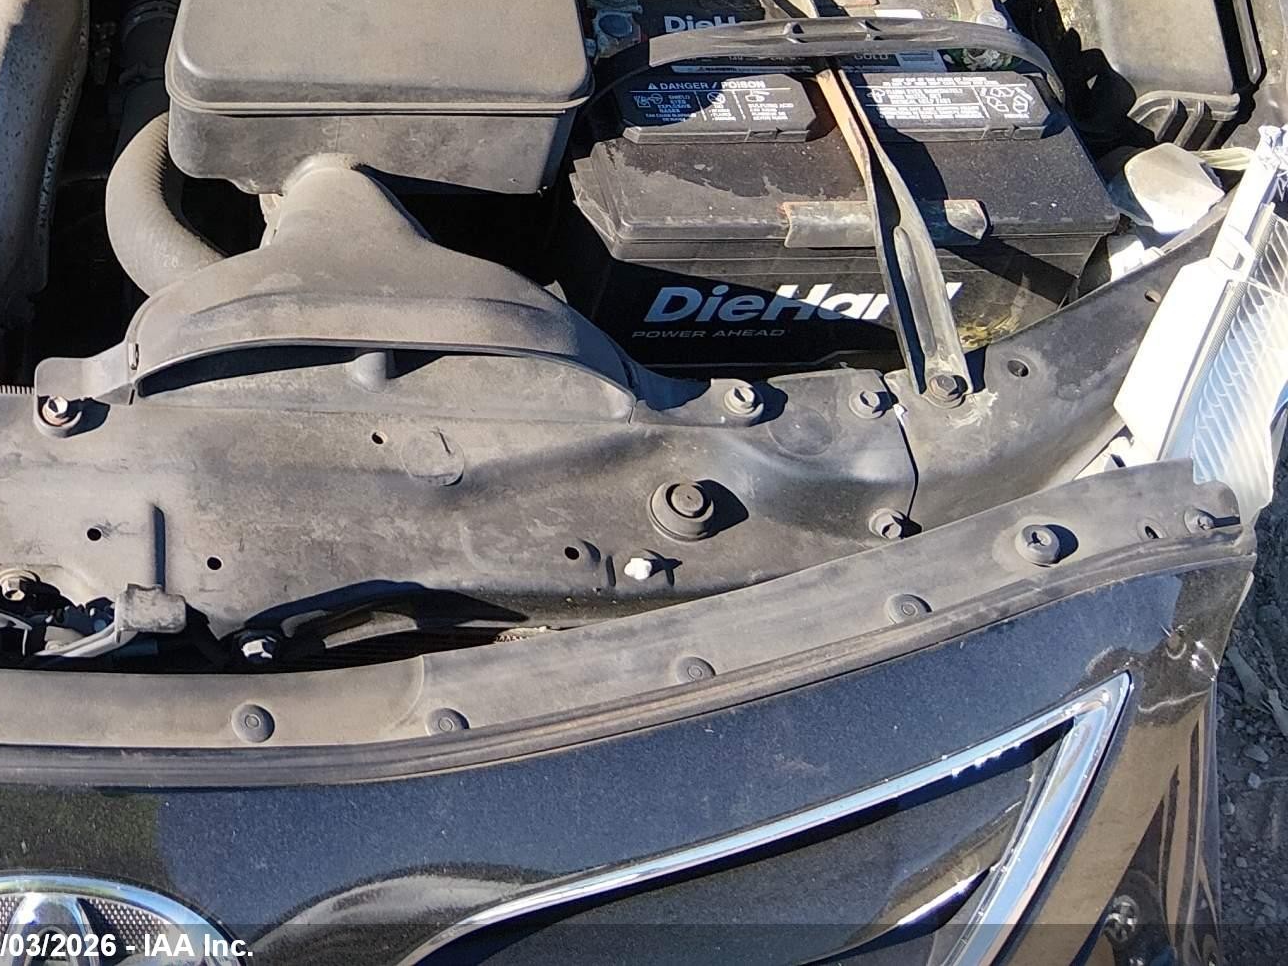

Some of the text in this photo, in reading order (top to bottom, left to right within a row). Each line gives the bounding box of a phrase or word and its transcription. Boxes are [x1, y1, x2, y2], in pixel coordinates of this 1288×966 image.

[659, 81, 709, 90] DANGER
[720, 80, 767, 90] POISON
[643, 282, 963, 323] DieHar
[632, 329, 785, 339] POWER AHEAD
